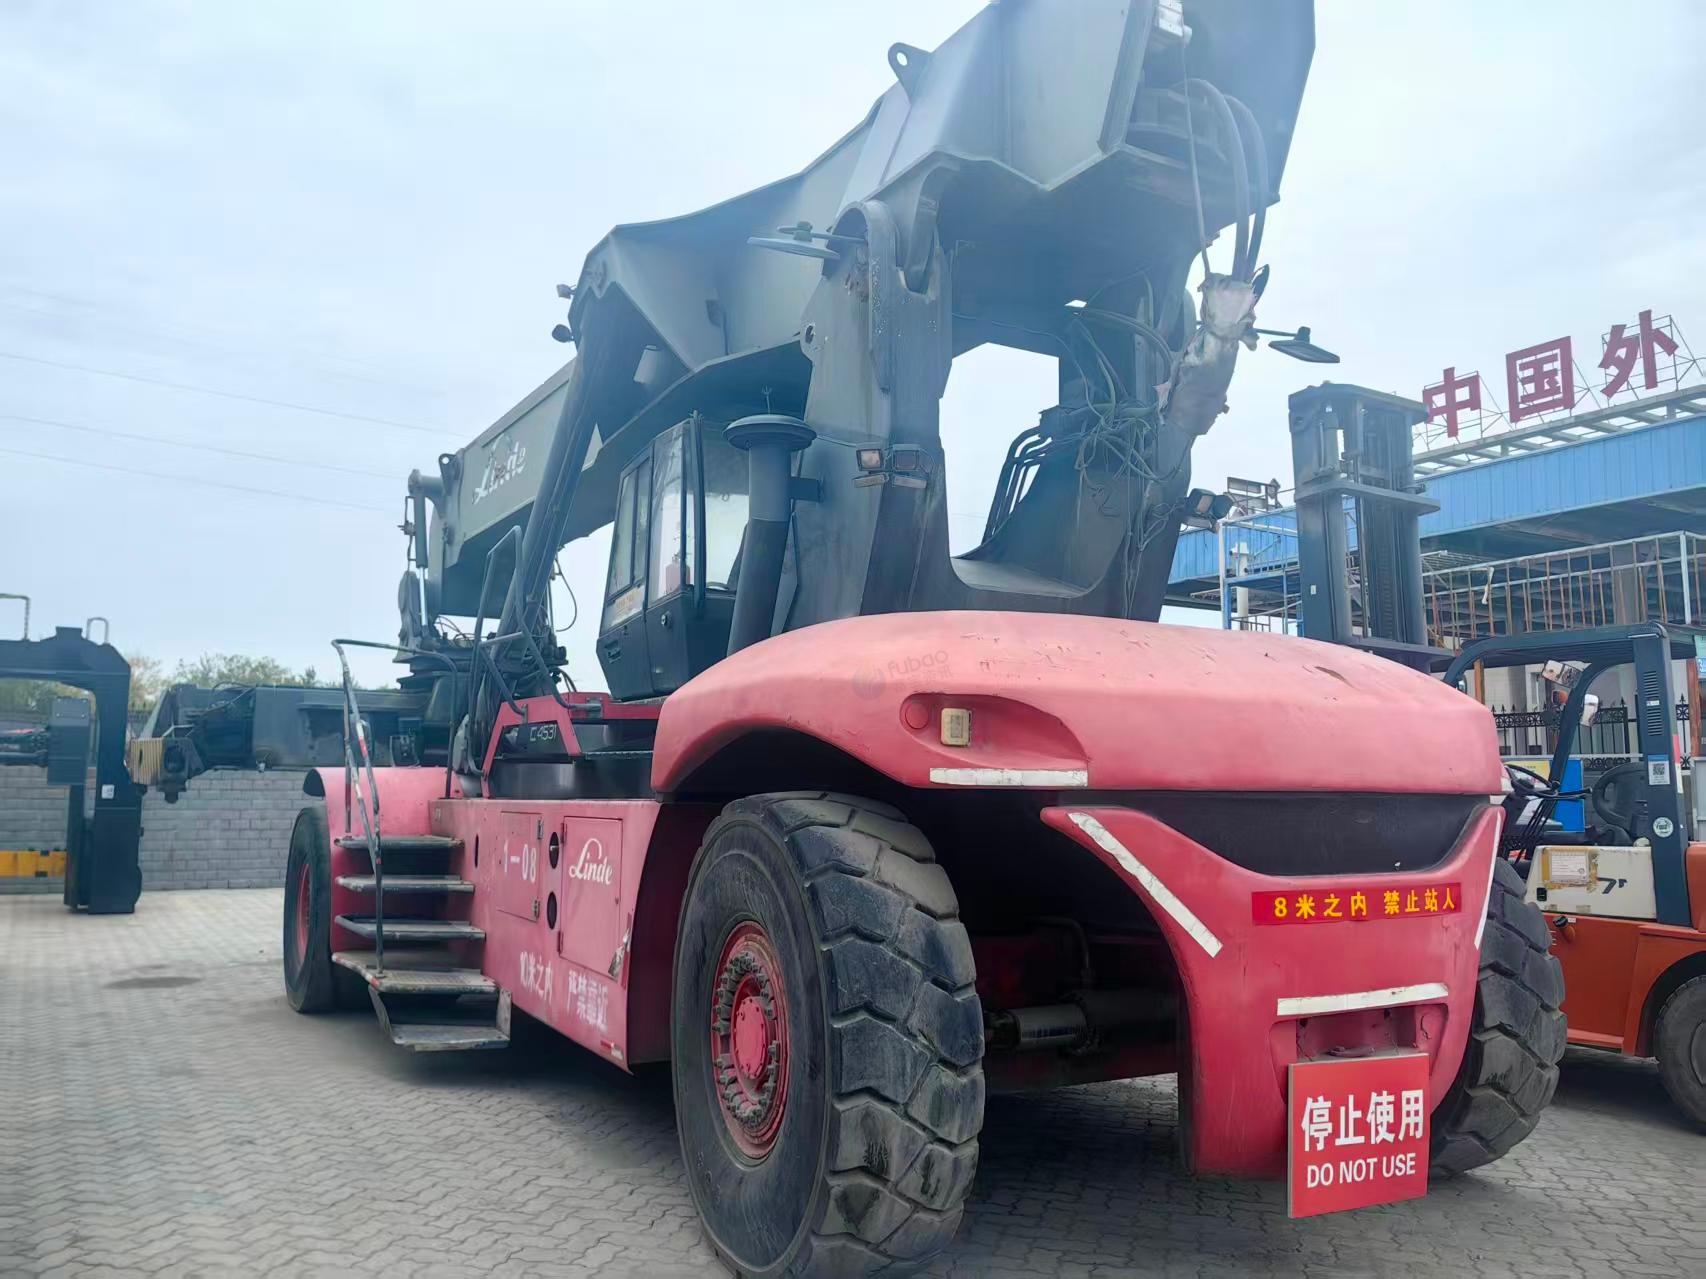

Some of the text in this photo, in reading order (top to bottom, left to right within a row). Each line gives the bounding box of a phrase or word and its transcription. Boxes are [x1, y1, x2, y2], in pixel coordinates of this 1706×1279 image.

[1422, 309, 1679, 438] 中国外
[569, 838, 612, 885] Linde
[1274, 887, 1455, 919] 8米之内 禁止站人
[1301, 1089, 1424, 1152] 停止使用
[1307, 1152, 1416, 1188] DO NOT USE
